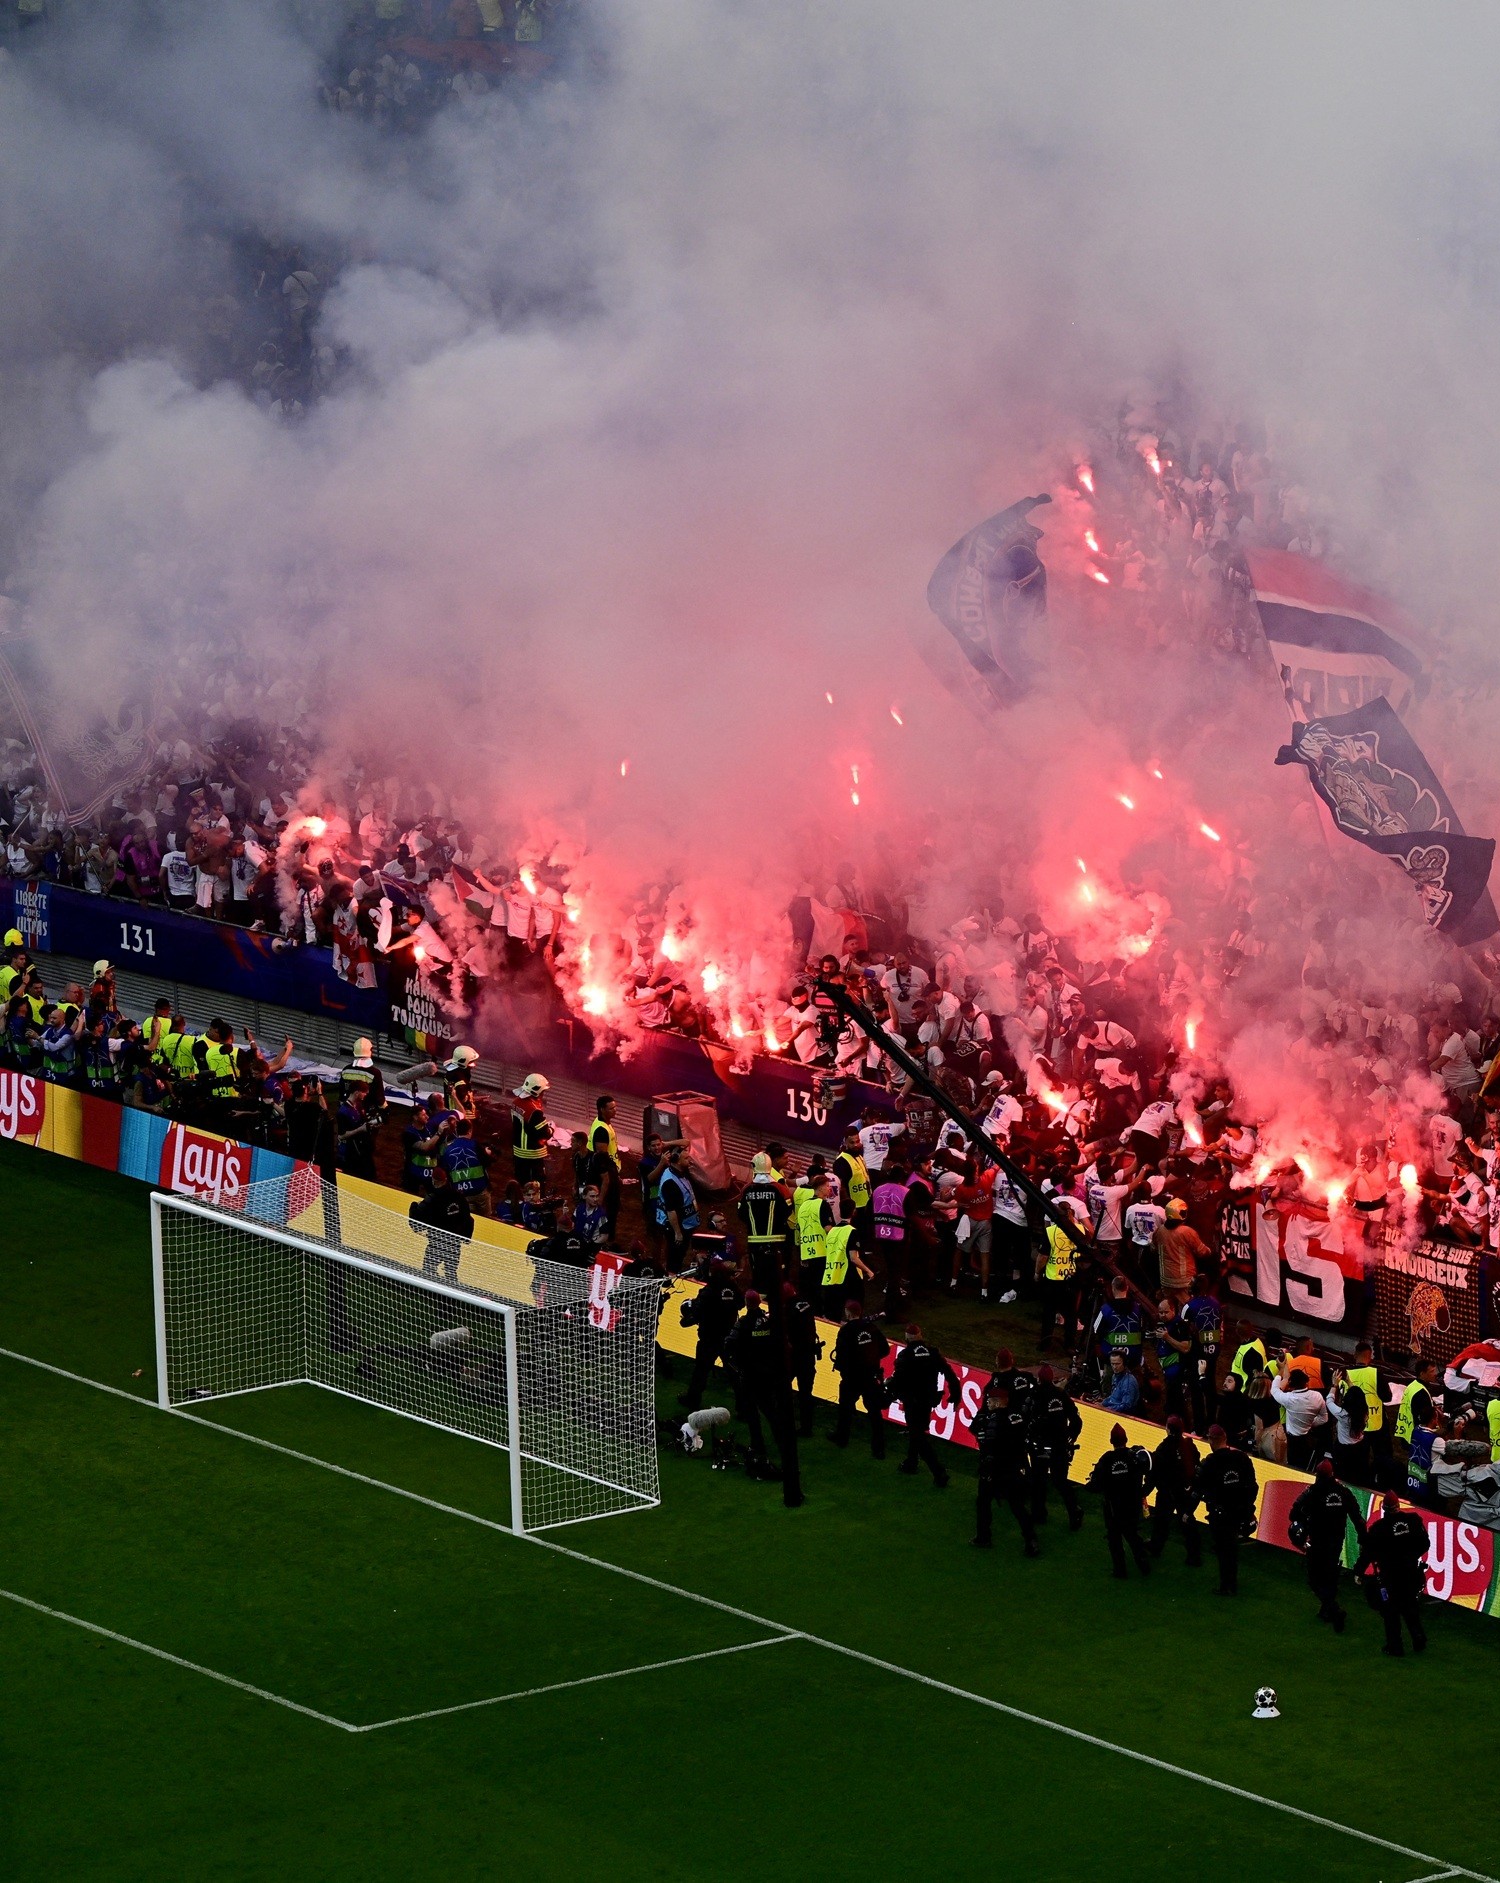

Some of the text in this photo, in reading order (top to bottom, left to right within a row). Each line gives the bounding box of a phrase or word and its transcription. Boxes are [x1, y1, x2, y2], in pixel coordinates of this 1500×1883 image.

[120, 922, 156, 957] 131
[406, 997, 436, 1019] POUR
[171, 1124, 241, 1204] Lay's
[456, 1169, 469, 1180] TV
[457, 1181, 474, 1191] 461
[880, 1227, 892, 1237] 63
[1432, 1243, 1446, 1260] JE
[1447, 1246, 1474, 1266] SUIS
[1385, 1245, 1468, 1289] AMOUREUX
